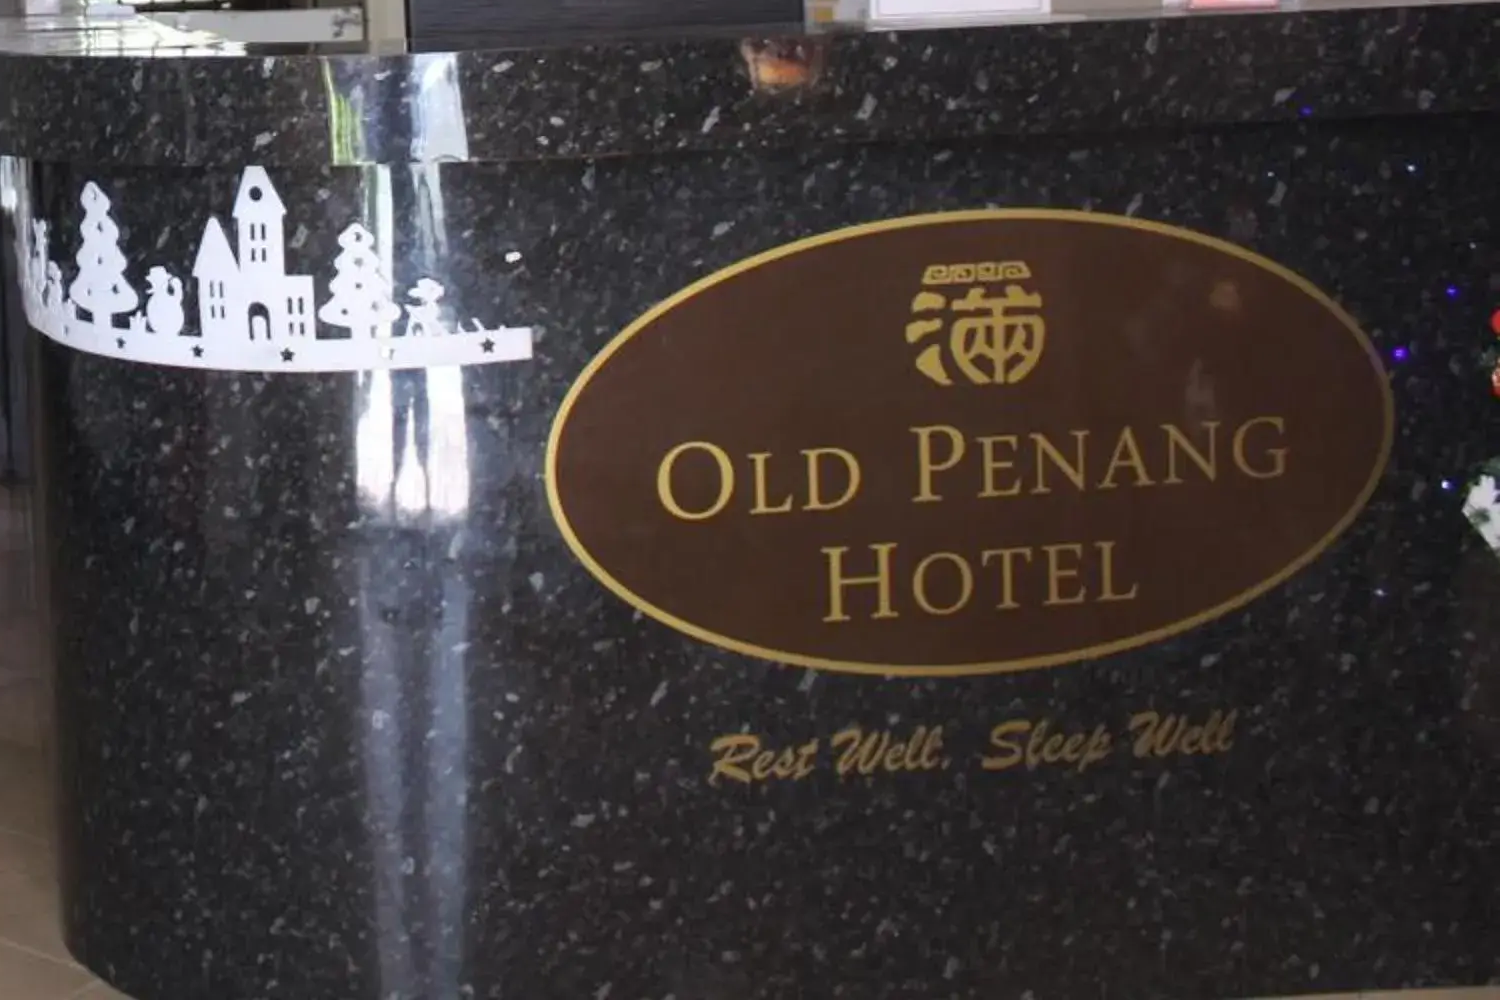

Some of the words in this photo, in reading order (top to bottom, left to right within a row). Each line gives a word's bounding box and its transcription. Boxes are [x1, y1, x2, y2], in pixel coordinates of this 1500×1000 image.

[656, 440, 862, 521] OLD
[910, 416, 1290, 504] PENANG
[821, 540, 1140, 624] HOTEL
[707, 733, 820, 787] Rest
[981, 719, 1115, 773] Sleep
[1128, 708, 1239, 759] Well
